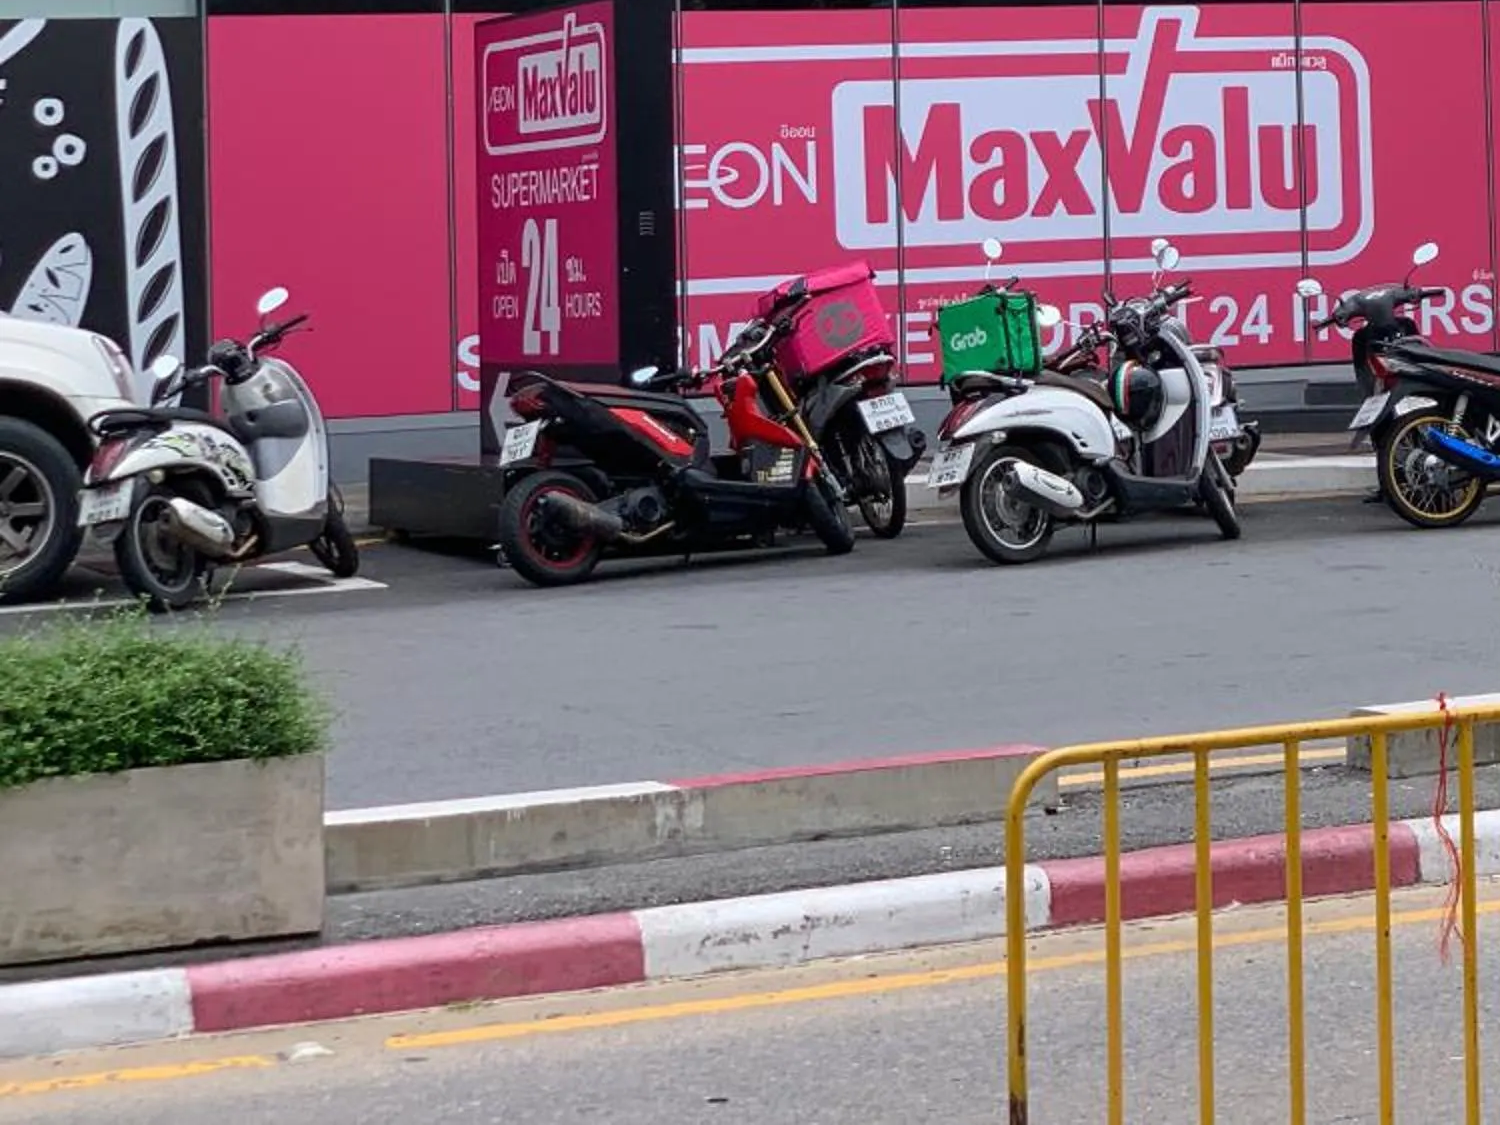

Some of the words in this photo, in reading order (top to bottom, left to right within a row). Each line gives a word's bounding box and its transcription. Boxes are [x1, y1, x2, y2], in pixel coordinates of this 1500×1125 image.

[521, 19, 597, 122] MaxValu
[861, 18, 1318, 225] MaxValu
[491, 163, 600, 209] SUPERMARKET
[493, 295, 519, 320] OPEN
[564, 291, 602, 319] HOURS
[521, 218, 562, 355] 24
[950, 326, 987, 352] Grab
[1208, 293, 1273, 347] 24
